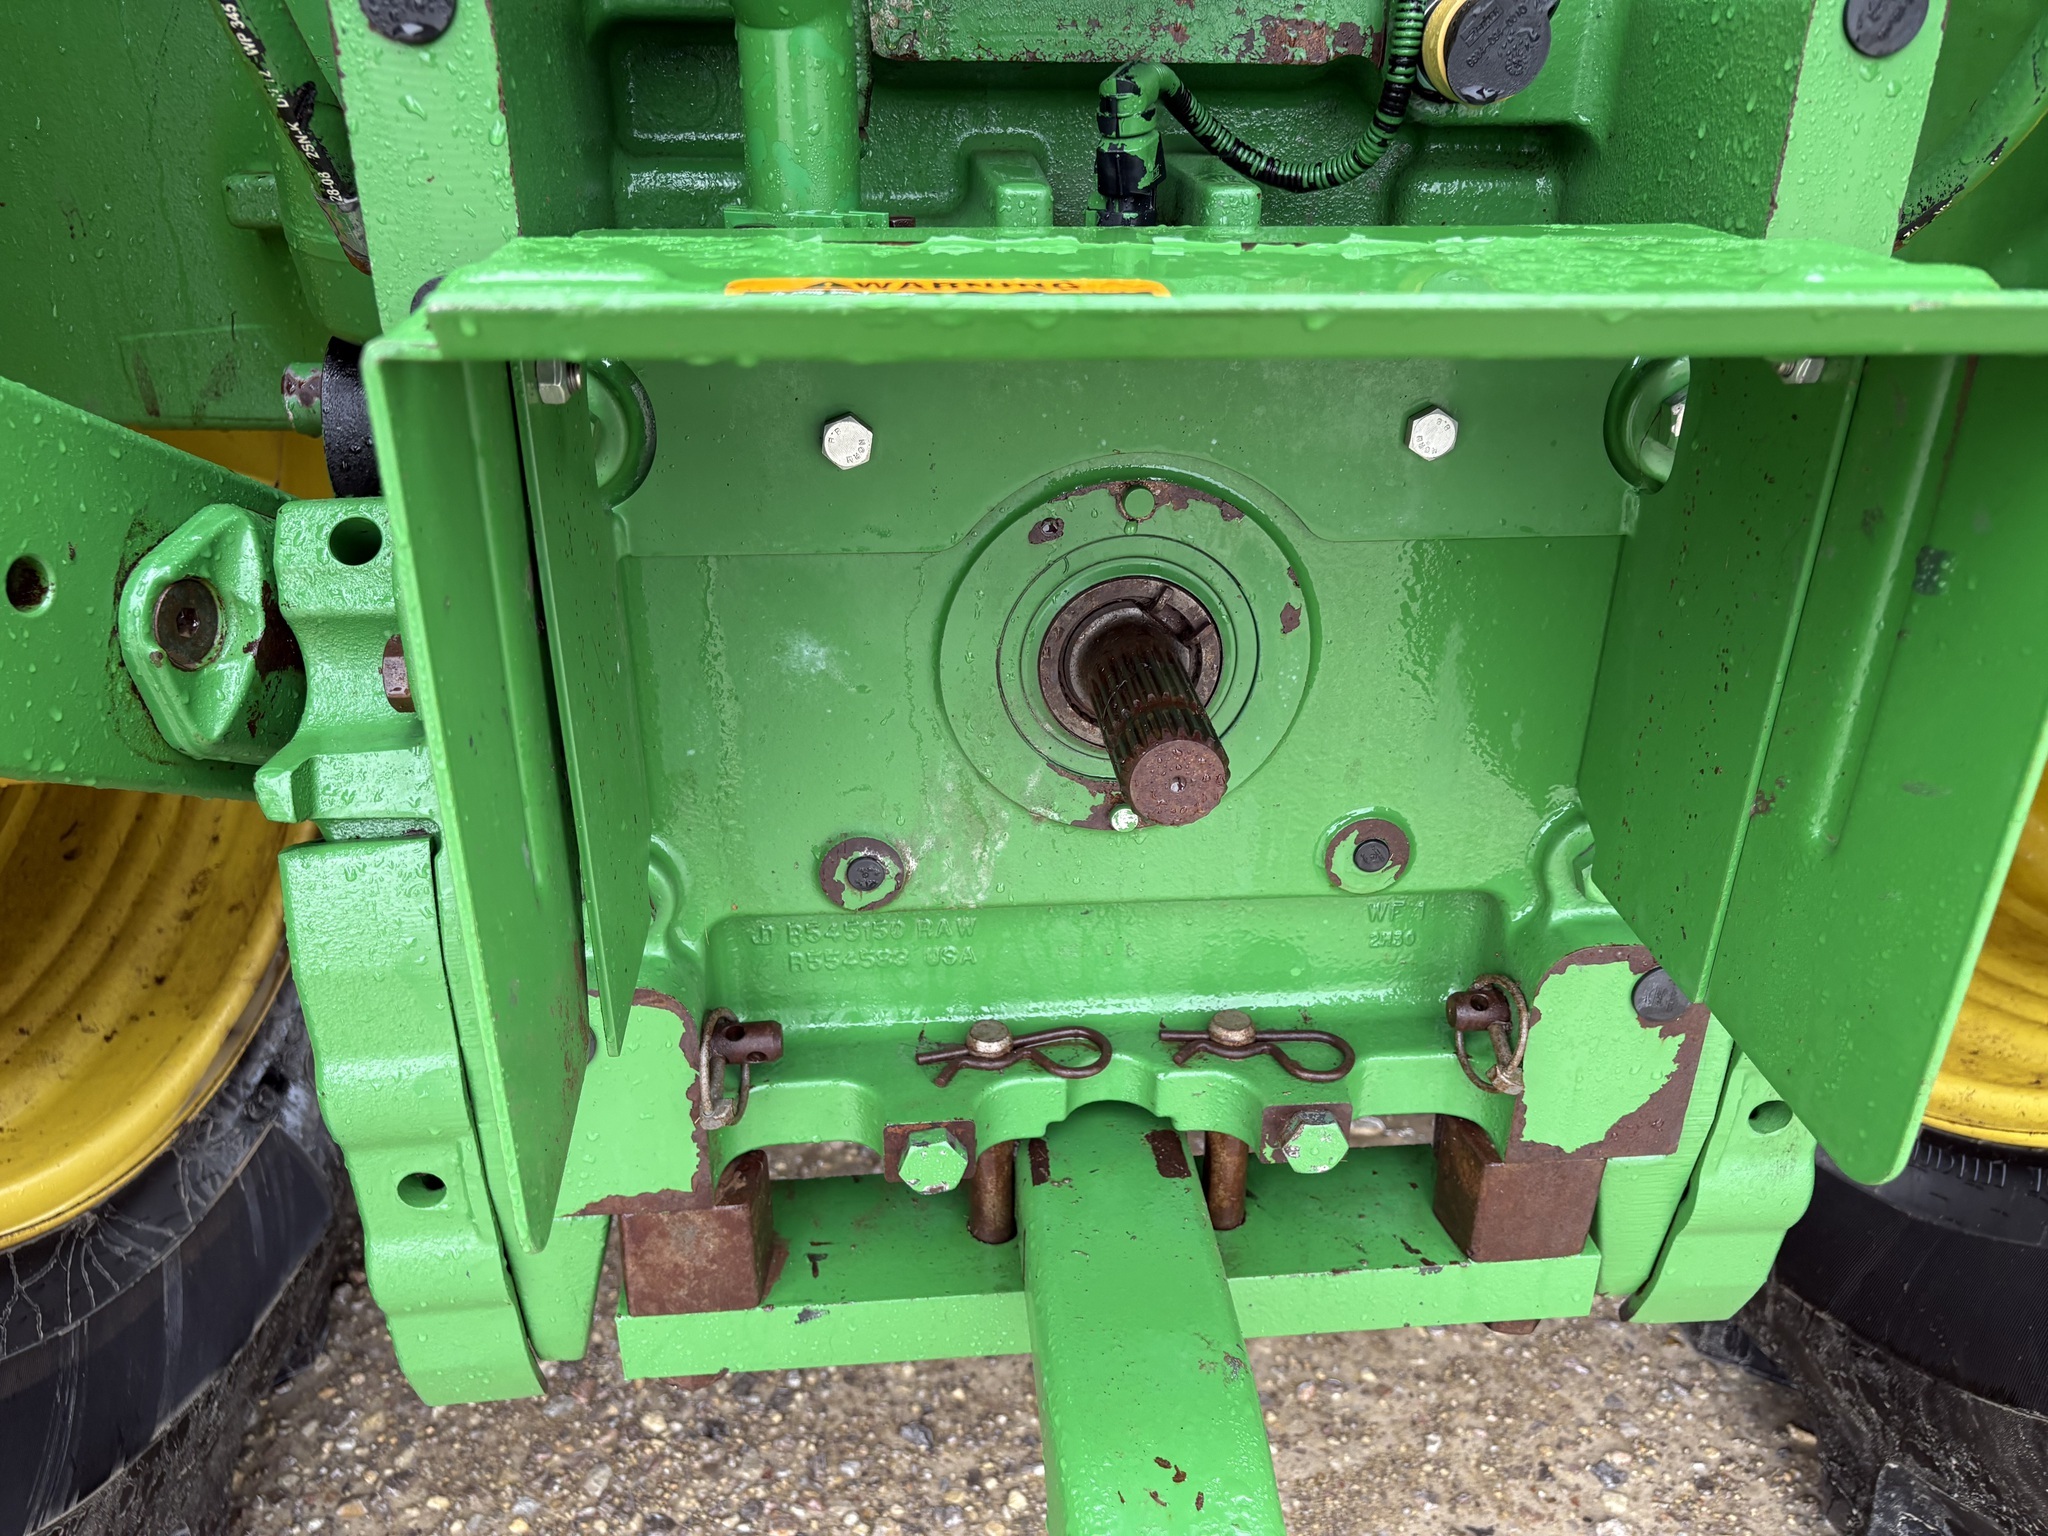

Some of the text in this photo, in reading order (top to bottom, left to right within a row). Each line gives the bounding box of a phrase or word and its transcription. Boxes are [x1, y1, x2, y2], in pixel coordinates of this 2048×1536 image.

[220, 3, 246, 30] 345
[236, 32, 260, 56] WP
[287, 121, 320, 159] 2SN-K
[317, 171, 342, 202] 28-08
[854, 281, 1080, 292] WARNING
[1367, 899, 1406, 922] WF
[916, 917, 978, 940] RAW
[924, 945, 978, 967] USA
